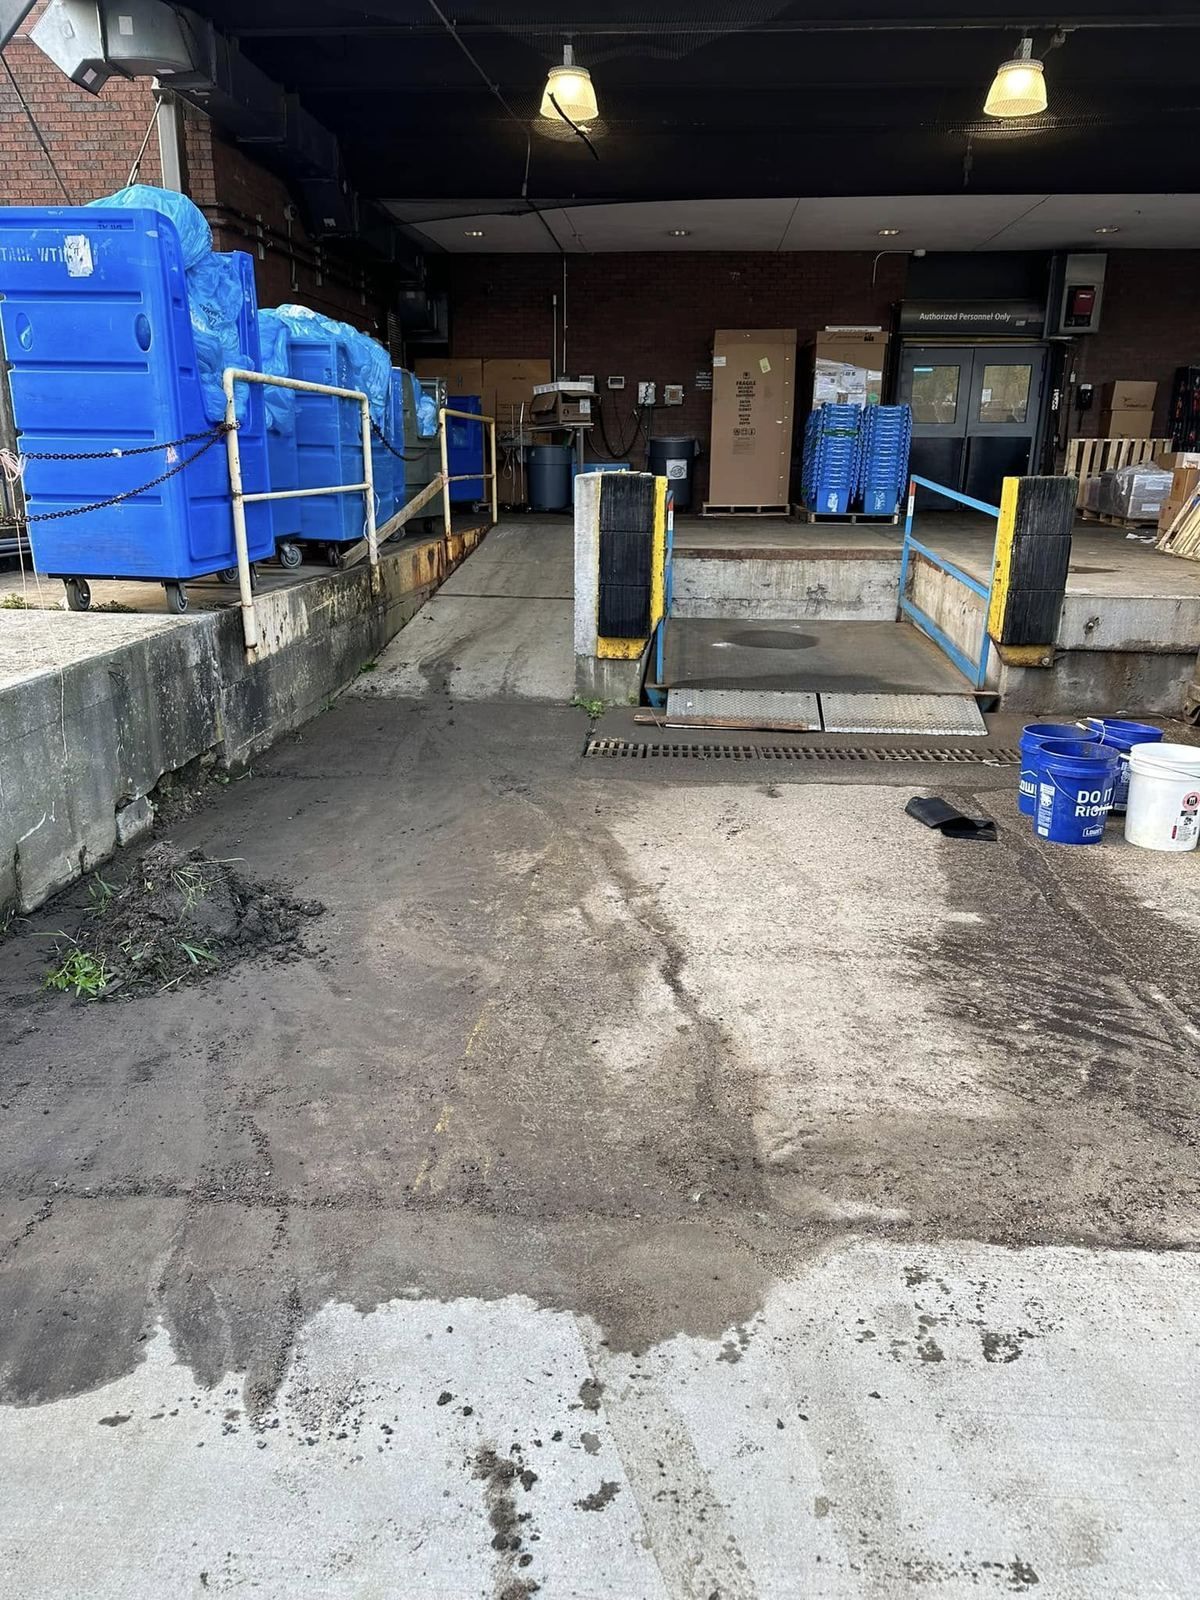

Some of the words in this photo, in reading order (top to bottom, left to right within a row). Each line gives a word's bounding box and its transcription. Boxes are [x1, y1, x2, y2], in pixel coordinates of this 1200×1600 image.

[959, 312, 993, 320] Personnel
[994, 312, 1011, 322] Only
[1076, 790, 1101, 804] DO
[1103, 787, 1113, 802] IT
